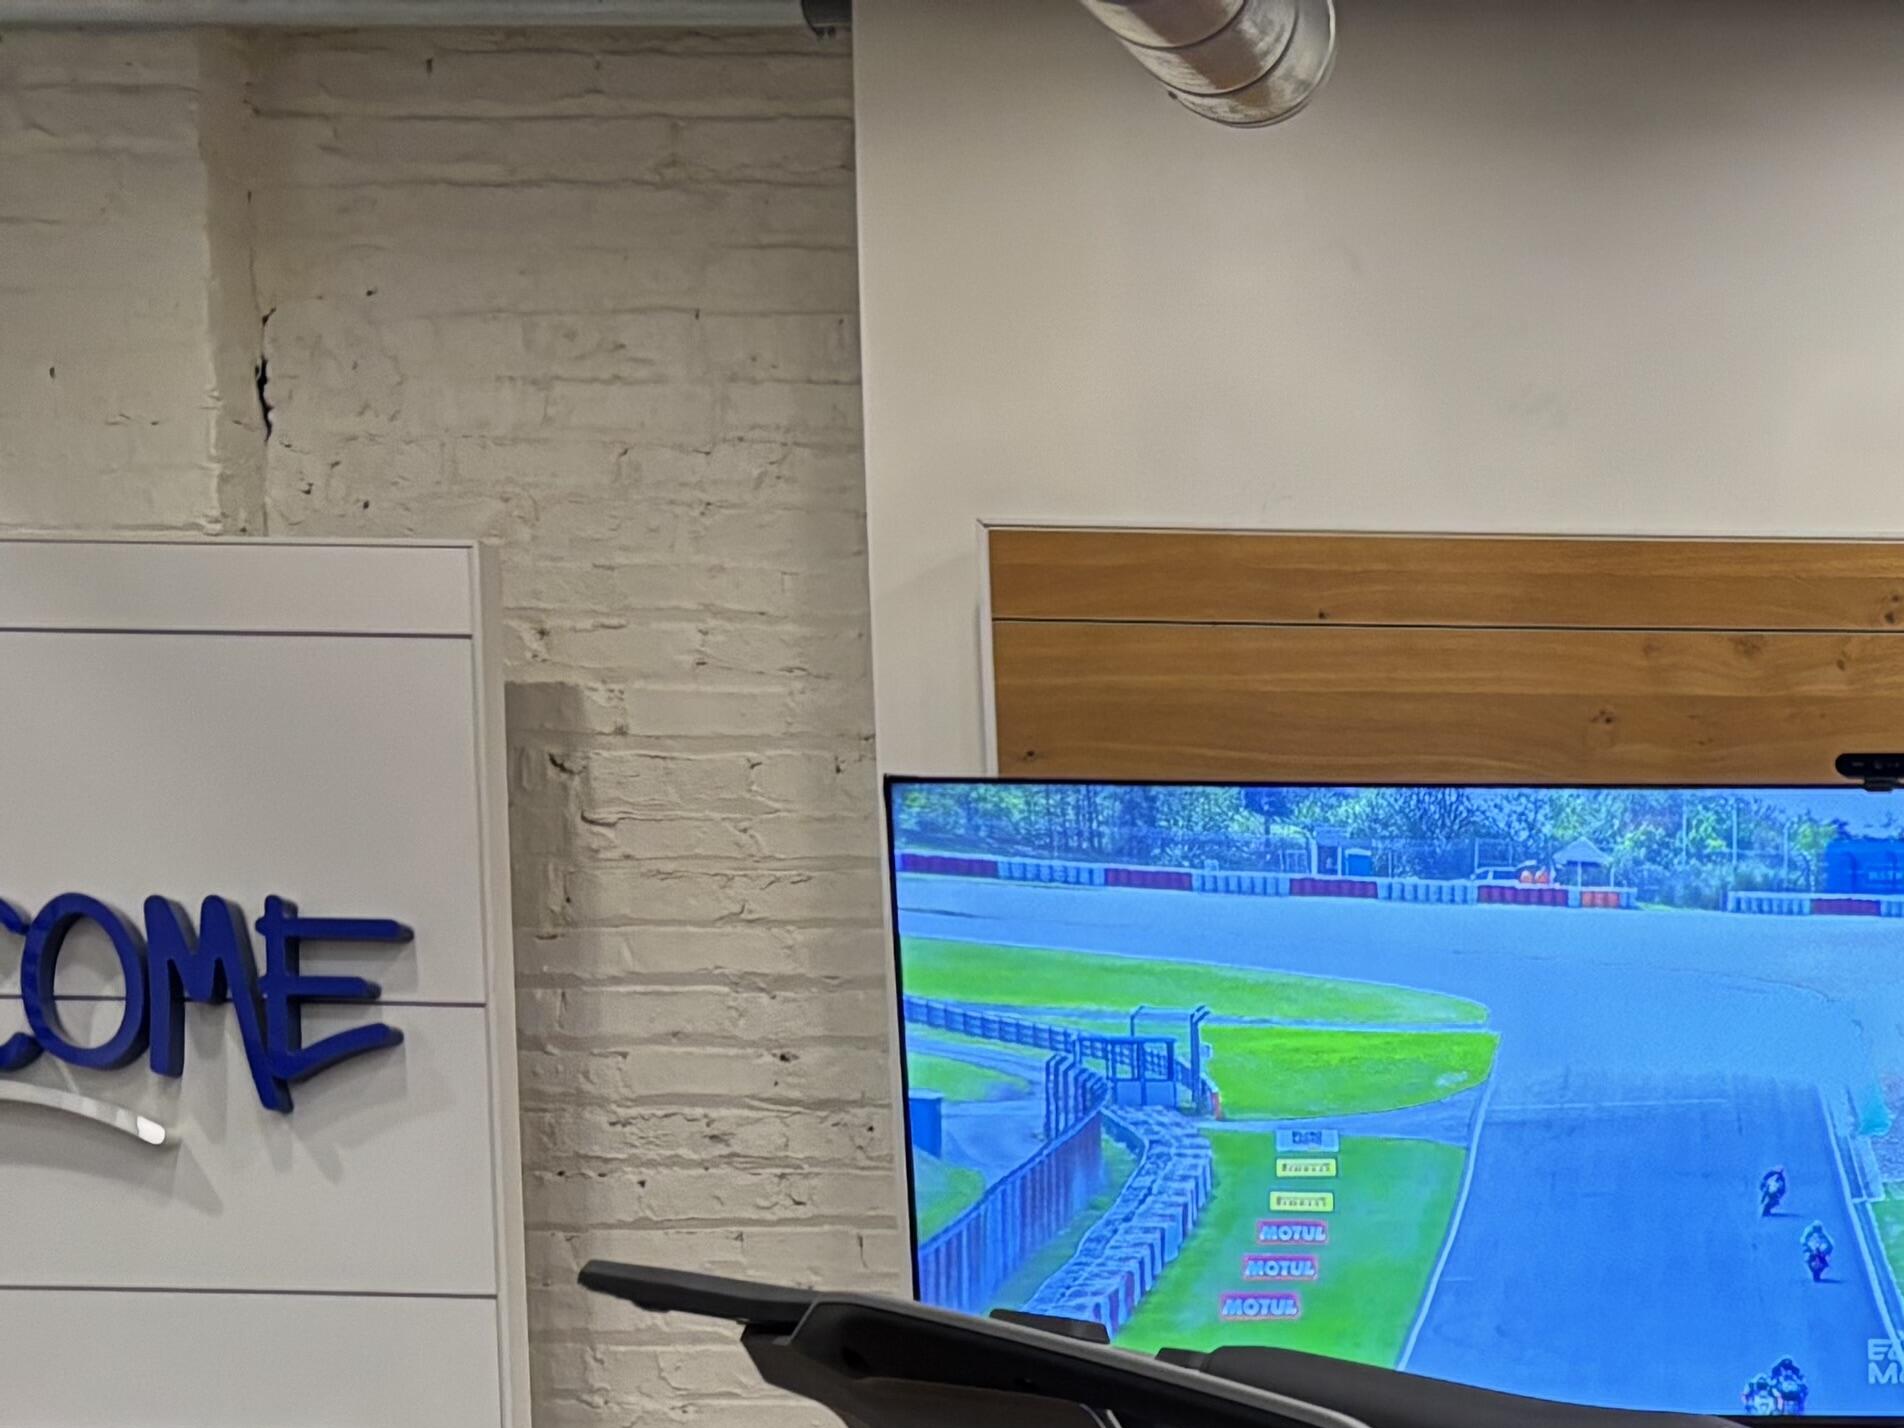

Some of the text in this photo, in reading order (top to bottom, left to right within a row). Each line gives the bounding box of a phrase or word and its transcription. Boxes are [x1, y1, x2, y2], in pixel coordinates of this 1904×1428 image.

[1259, 1225, 1327, 1241] MOTUL
[1245, 1260, 1315, 1276] MOTUL
[1221, 1298, 1298, 1316] MOTUL
